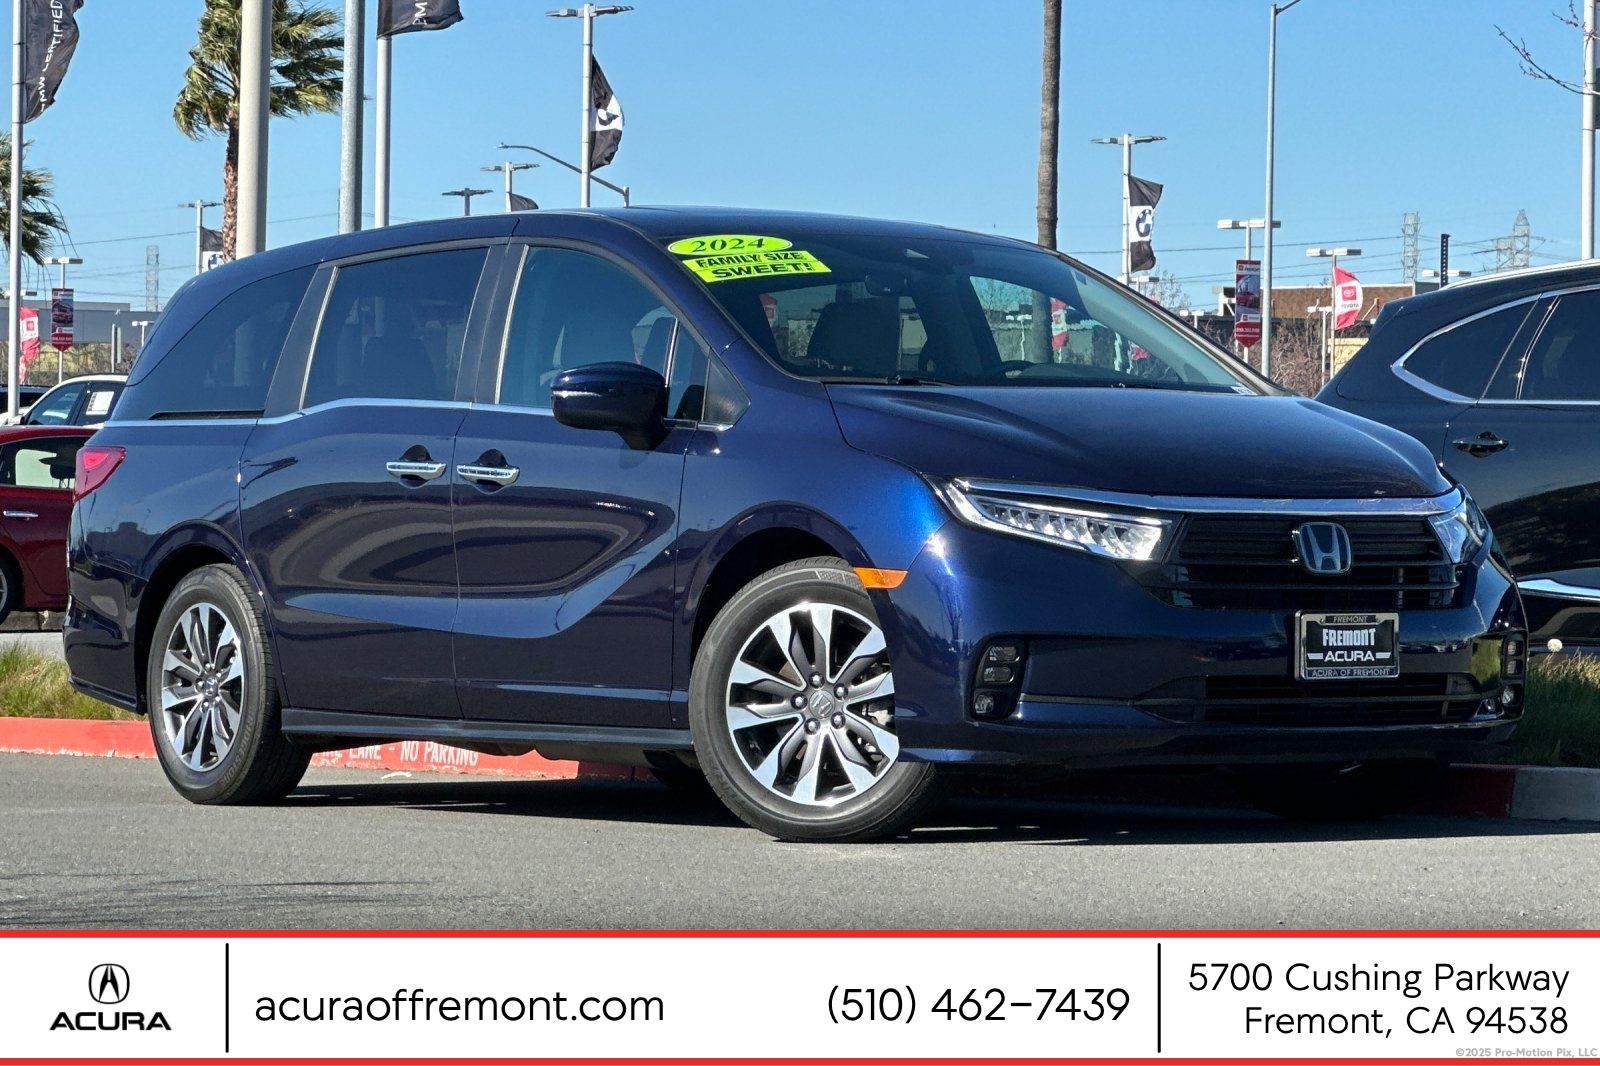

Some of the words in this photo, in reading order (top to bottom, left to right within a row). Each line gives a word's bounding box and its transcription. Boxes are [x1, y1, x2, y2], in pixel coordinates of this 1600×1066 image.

[690, 238, 766, 253] 2024
[696, 253, 760, 268] FAMILY
[764, 251, 806, 261] SIZE
[711, 262, 814, 279] SWEET!
[1333, 615, 1368, 623] FREMONT
[1322, 628, 1376, 646] FREMONT
[1324, 650, 1375, 662] ACURA
[1312, 669, 1338, 677] ACURA
[1353, 668, 1390, 676] FREMONT
[400, 741, 419, 761] NO
[424, 741, 479, 767] PARKING
